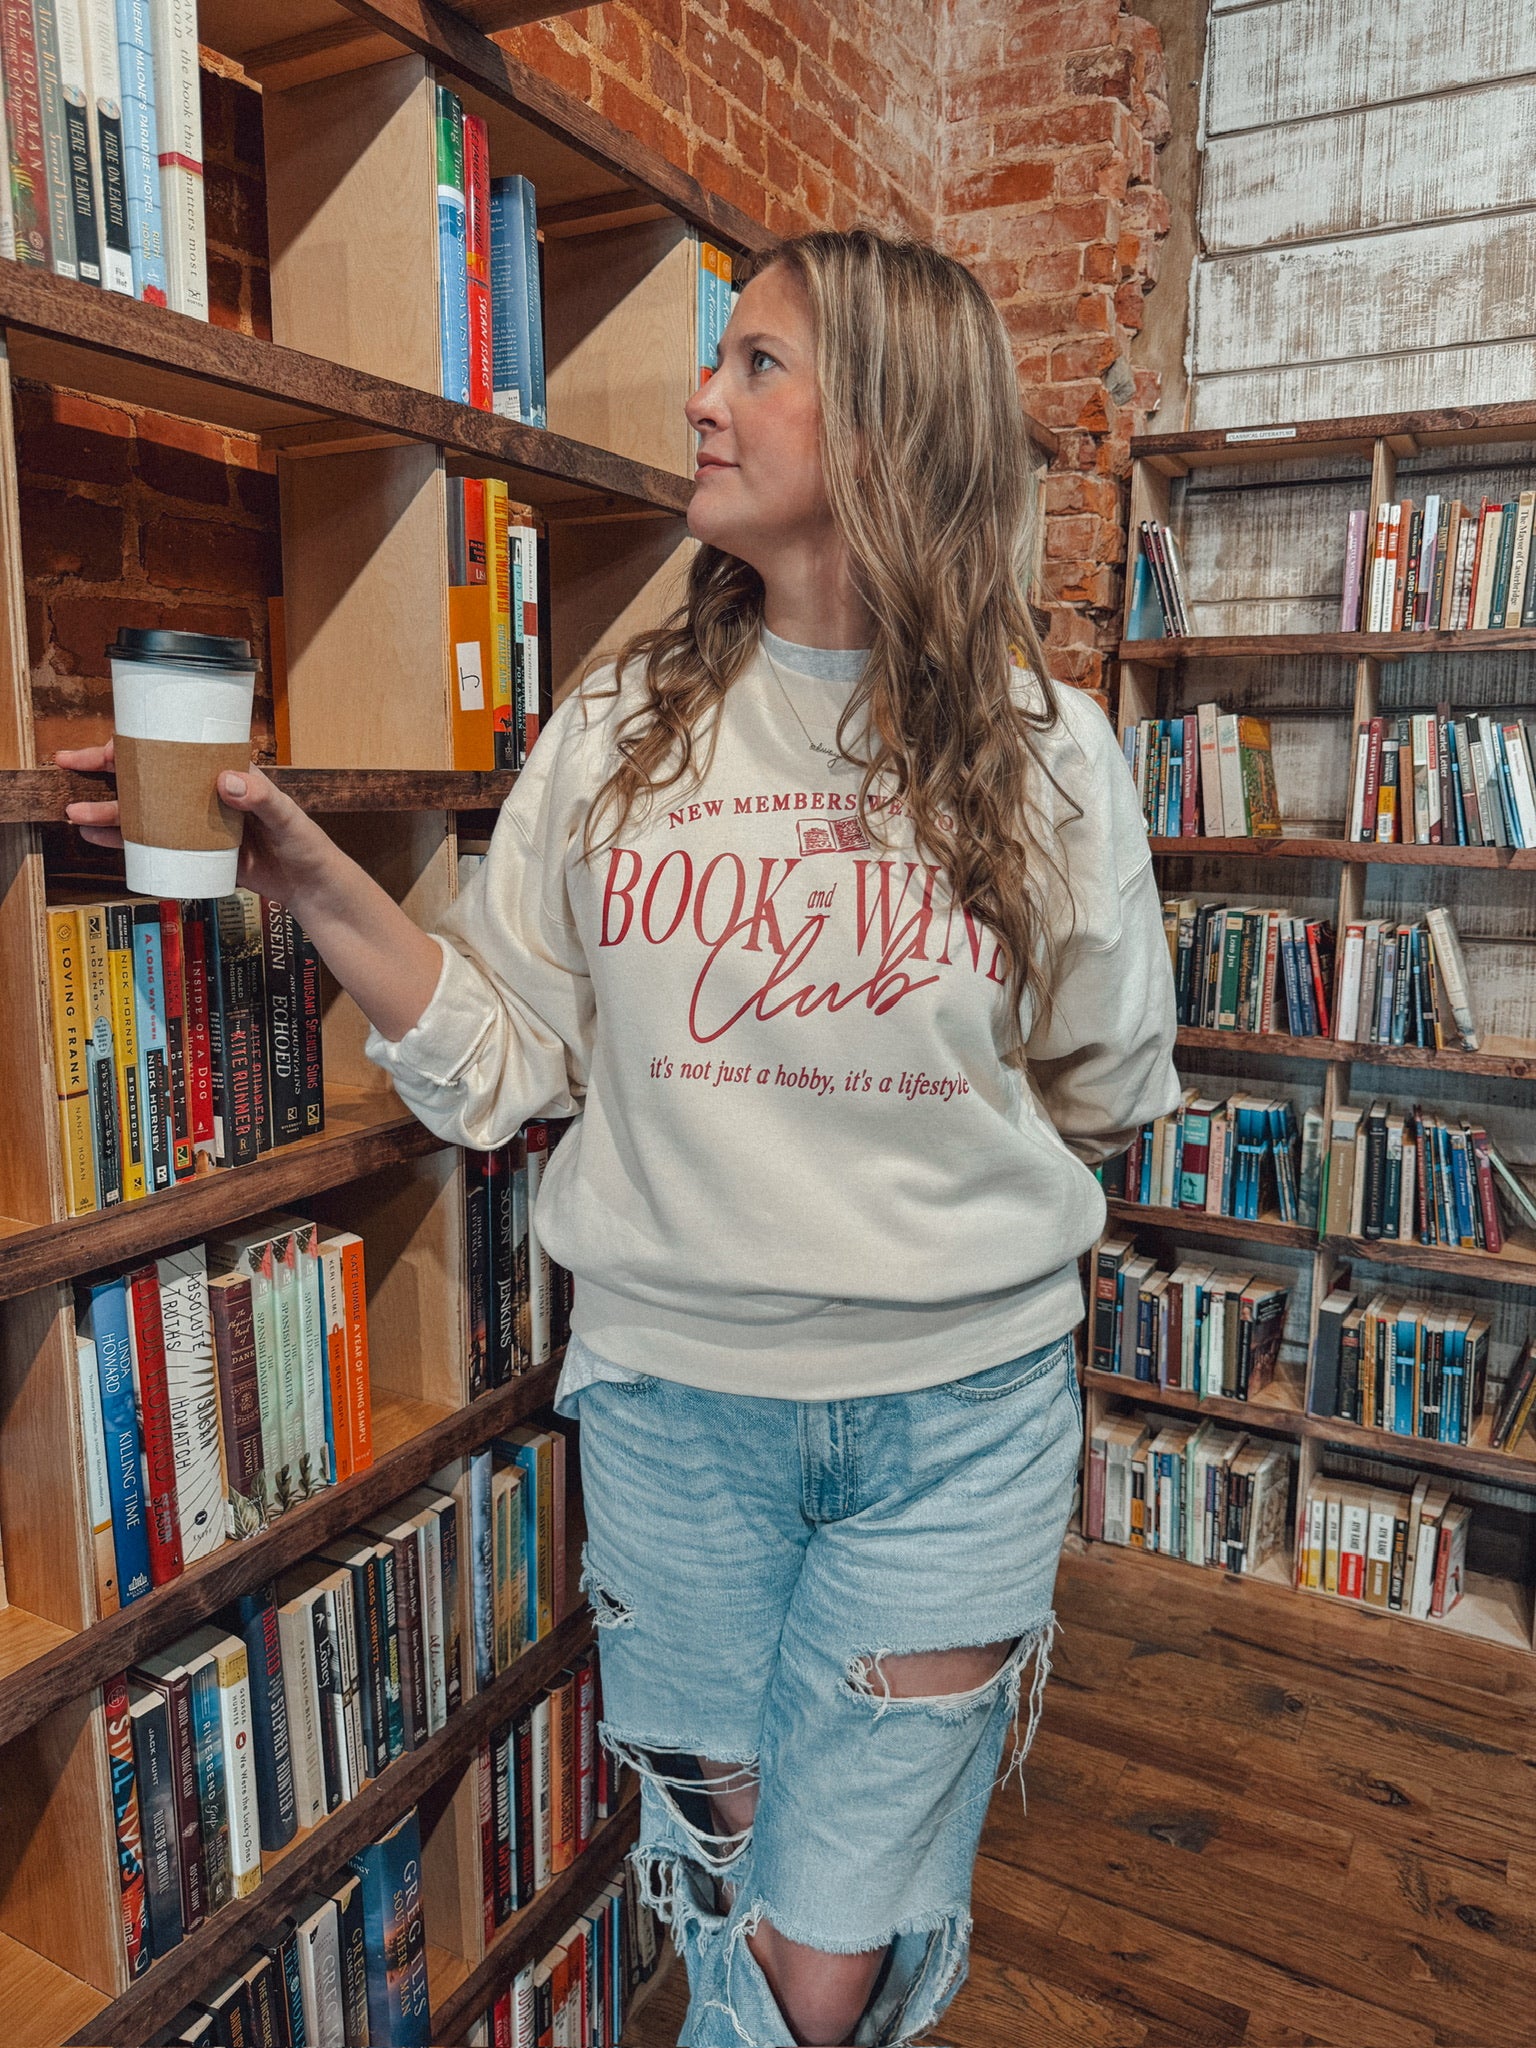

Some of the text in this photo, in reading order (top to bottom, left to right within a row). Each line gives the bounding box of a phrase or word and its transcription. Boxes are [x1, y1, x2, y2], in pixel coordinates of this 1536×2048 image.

[22, 51, 43, 172] HOFFMAN
[69, 119, 91, 217] HERE ON EARTH
[104, 130, 123, 227] HERE ON EARTH
[139, 113, 154, 214] PARADISE HOTEL
[182, 80, 198, 276] book matters most
[450, 102, 463, 189] Long Time
[471, 127, 483, 249] SEYMOUR BROWN
[141, 221, 151, 260] HOGAN
[152, 230, 161, 258] RUTH
[456, 208, 465, 260] No See
[478, 295, 489, 389] SUSAN ISAACS
[1228, 432, 1259, 441] CLASSICAL
[494, 494, 509, 614] THE BULLET SWALLOWER
[1510, 510, 1529, 606] The Mayor of Casterbridge
[515, 597, 524, 637] JAMES
[1404, 571, 1416, 627] LORD FLIES
[499, 667, 508, 694] JAMES
[516, 695, 524, 730] WOMAN
[1367, 733, 1379, 795] THE SCARLET LETTER
[1438, 724, 1448, 753] Scarlet
[1440, 754, 1449, 779] Letter
[668, 800, 724, 829] NEW
[733, 792, 857, 815] MEMBERS
[599, 847, 803, 956] BOOK
[806, 882, 838, 909] and
[90, 945, 99, 1012] HORNBY
[97, 958, 105, 996] NICK
[121, 954, 129, 989] NICK
[145, 934, 156, 1011] A LONG WAY
[303, 966, 317, 1015] THOUSAND
[305, 958, 314, 966] A
[688, 899, 940, 1044] Club
[61, 947, 80, 1085] LOVING FRANK
[123, 997, 134, 1056] HORNBY
[193, 960, 208, 1100] INSIDE OF A DOG
[272, 995, 292, 1078] ECHOED
[305, 1018, 318, 1062] SPLENDID
[169, 1024, 181, 1132] FIDELITY
[230, 1030, 251, 1136] KITE RUNNER
[291, 1018, 300, 1096] MOUNTAINS
[307, 1063, 320, 1089] SUNS
[649, 1056, 970, 1102] it's not just a hobby, it's a lifestyle
[75, 1107, 83, 1141] NANCY
[147, 1055, 160, 1152] NICK HORNBY
[138, 1272, 164, 1362] LINDA
[162, 1288, 182, 1351] TRUTHS
[187, 1271, 206, 1352] ABSOLUTE
[330, 1285, 338, 1317] HULME
[350, 1253, 360, 1321] KATE HUMBLE
[497, 1279, 511, 1348] JENKINS
[102, 1333, 120, 1394] HOWARD
[118, 1337, 131, 1379] LINDA
[231, 1350, 255, 1365] DANE
[257, 1311, 270, 1423] SPANISH DAUGHTER
[281, 1301, 294, 1410] SPANISH DAUGHTER
[353, 1323, 367, 1444] A YEAR OF LIVING SIMPLY
[171, 1398, 191, 1470] HOWATCH
[196, 1398, 214, 1450] SUSAN
[119, 1430, 141, 1531] KILLING TIME
[242, 1438, 253, 1477] HOWE
[1350, 1534, 1360, 1550] RAND
[1352, 1521, 1361, 1533] AYN
[1377, 1541, 1388, 1556] RAND
[1379, 1526, 1388, 1539] AYN
[262, 1605, 281, 1676] TARGETED
[367, 1562, 380, 1665] GREGG HURWITZ
[318, 1636, 330, 1689] Loney
[232, 1695, 240, 1726] HUNTER
[239, 1687, 247, 1725] GEORGIA
[304, 1706, 312, 1740] BLIND
[561, 1687, 572, 1769] IRIS JOHANSEN
[110, 1714, 134, 1794] STILL
[148, 1728, 159, 1786] JACK HUNT
[180, 1745, 192, 1776] VILLAGE
[203, 1720, 216, 1800] RIVERBEND
[270, 1695, 293, 1816] STEPHEN HUNTER
[240, 1770, 252, 1863] Were Lucky Ones
[496, 1741, 510, 1841] IRIS JOHANSEN
[153, 1808, 170, 1894] RULES OF SURVIVAL
[189, 1862, 198, 1888] ROSIE
[122, 1891, 138, 1948] Hummel
[403, 1859, 427, 2018] GREG ILES
[351, 1927, 368, 2037] GREG ILES
[393, 1888, 412, 2018] SOUTHERN MAN
[258, 1976, 268, 2001] THE
[321, 1955, 337, 2021] GREG
